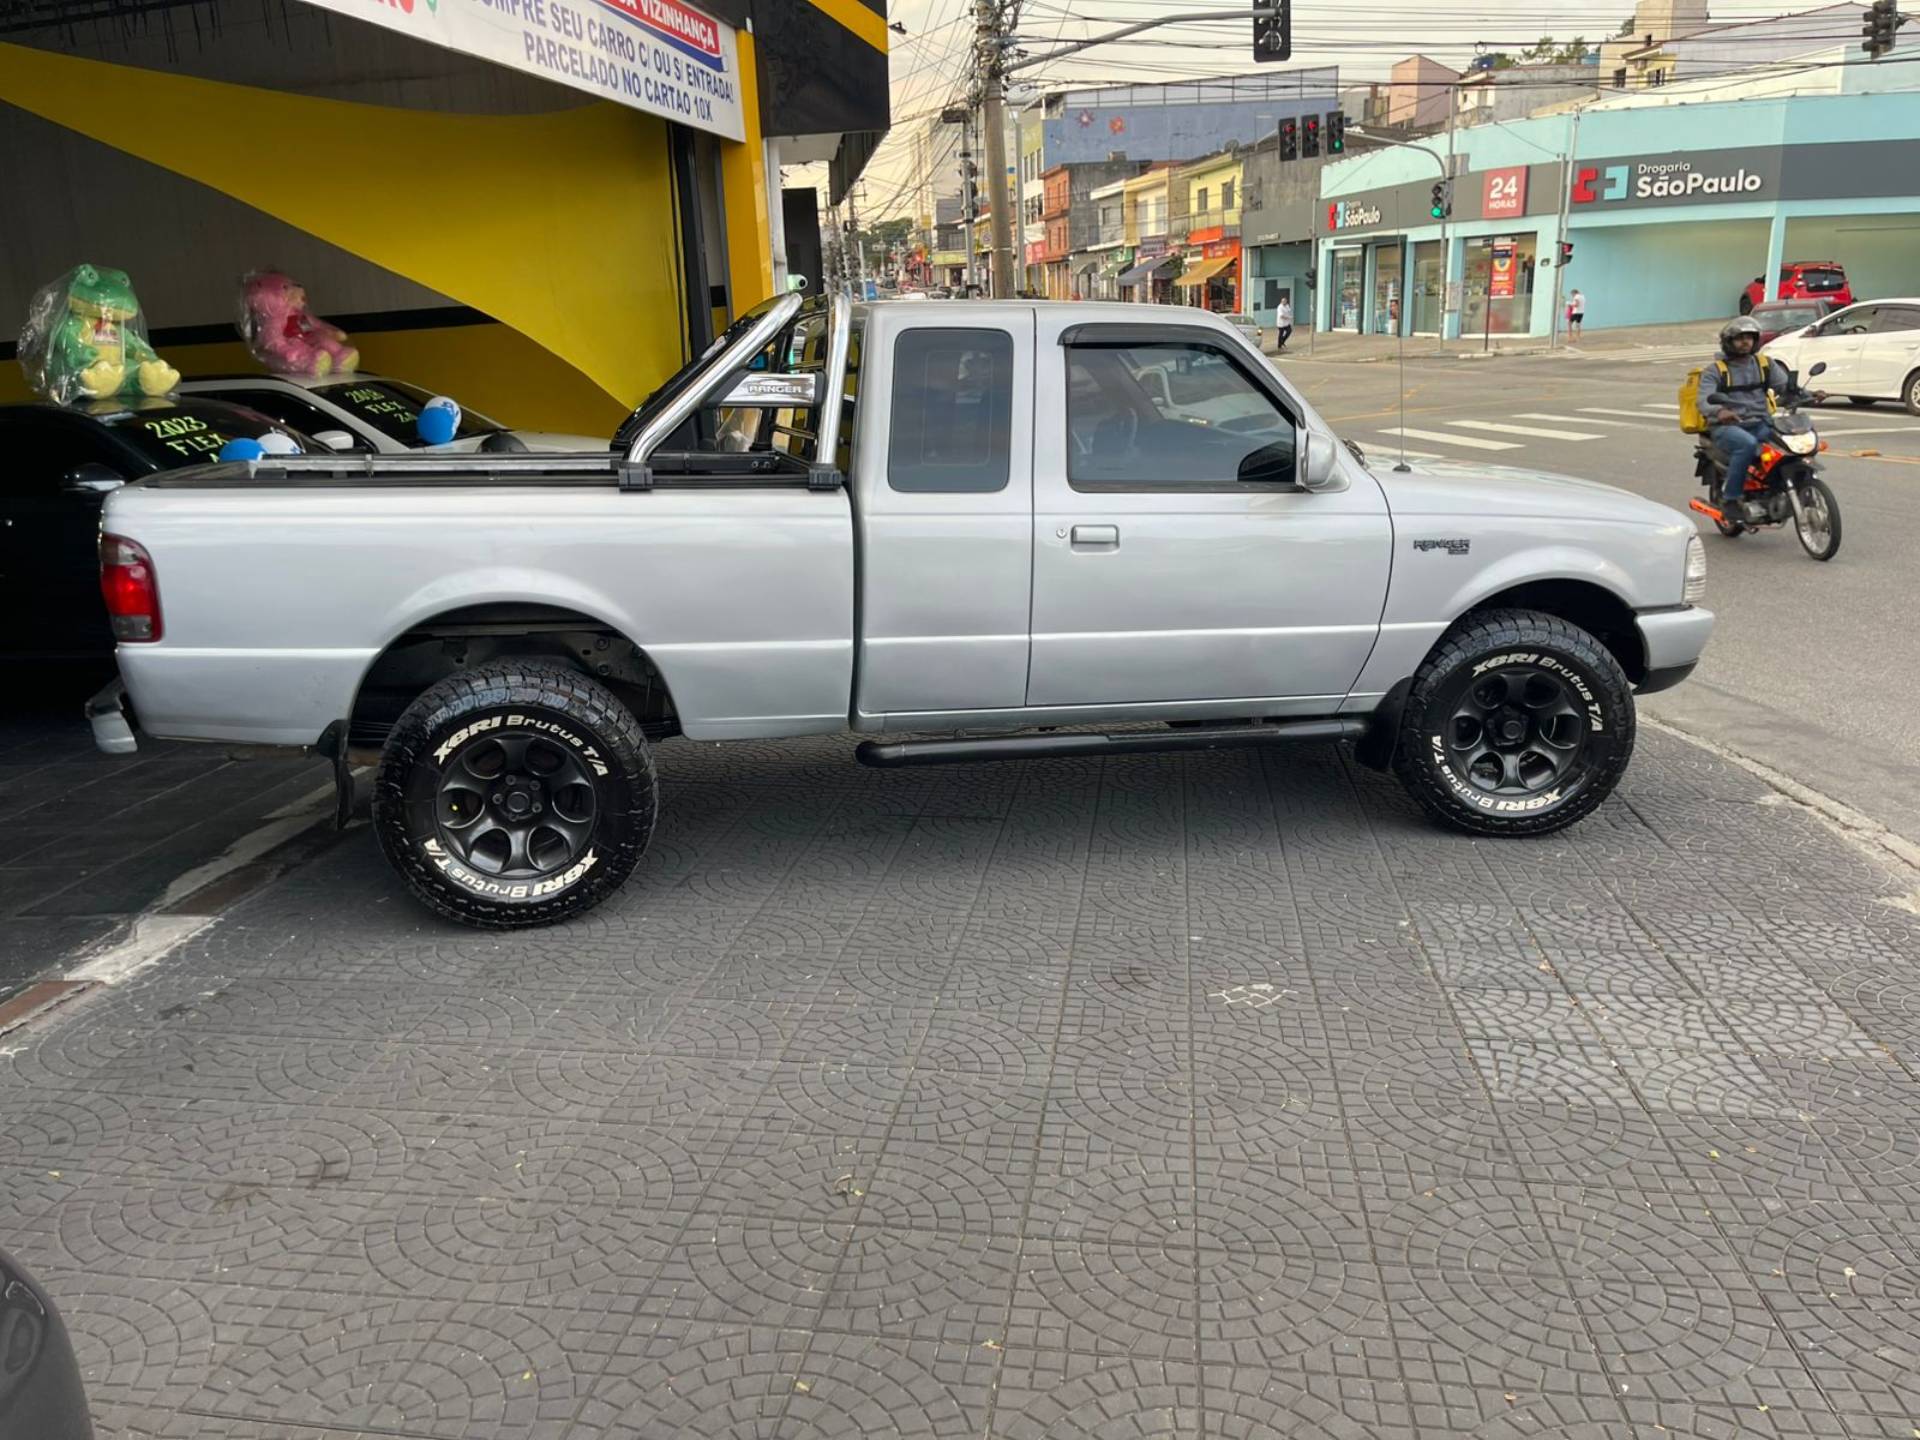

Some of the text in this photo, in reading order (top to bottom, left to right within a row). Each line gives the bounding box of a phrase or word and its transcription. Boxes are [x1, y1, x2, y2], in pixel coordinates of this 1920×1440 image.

[550, 2, 583, 41] SEU
[587, 17, 635, 63] CARRO
[654, 48, 671, 77] OU
[639, 0, 716, 49] VIZINHANÇA
[523, 30, 618, 90] PARCELADO
[622, 66, 641, 98] NO
[694, 96, 713, 122] 10X
[1490, 176, 1518, 200] 24
[1636, 168, 1762, 198] SãoPaulo
[1637, 161, 1691, 177] Drogaria
[1488, 199, 1517, 210] HORAS
[749, 385, 802, 393] RANGER
[145, 416, 208, 438] 2023
[166, 433, 229, 455] FLEX
[1472, 653, 1603, 731] XBRI Brutus T/A
[433, 714, 608, 776] XBRI Brutus T/A
[1431, 735, 1562, 811] XBRI Brutus T/A
[424, 838, 599, 897] XBRI Brutus T/A
